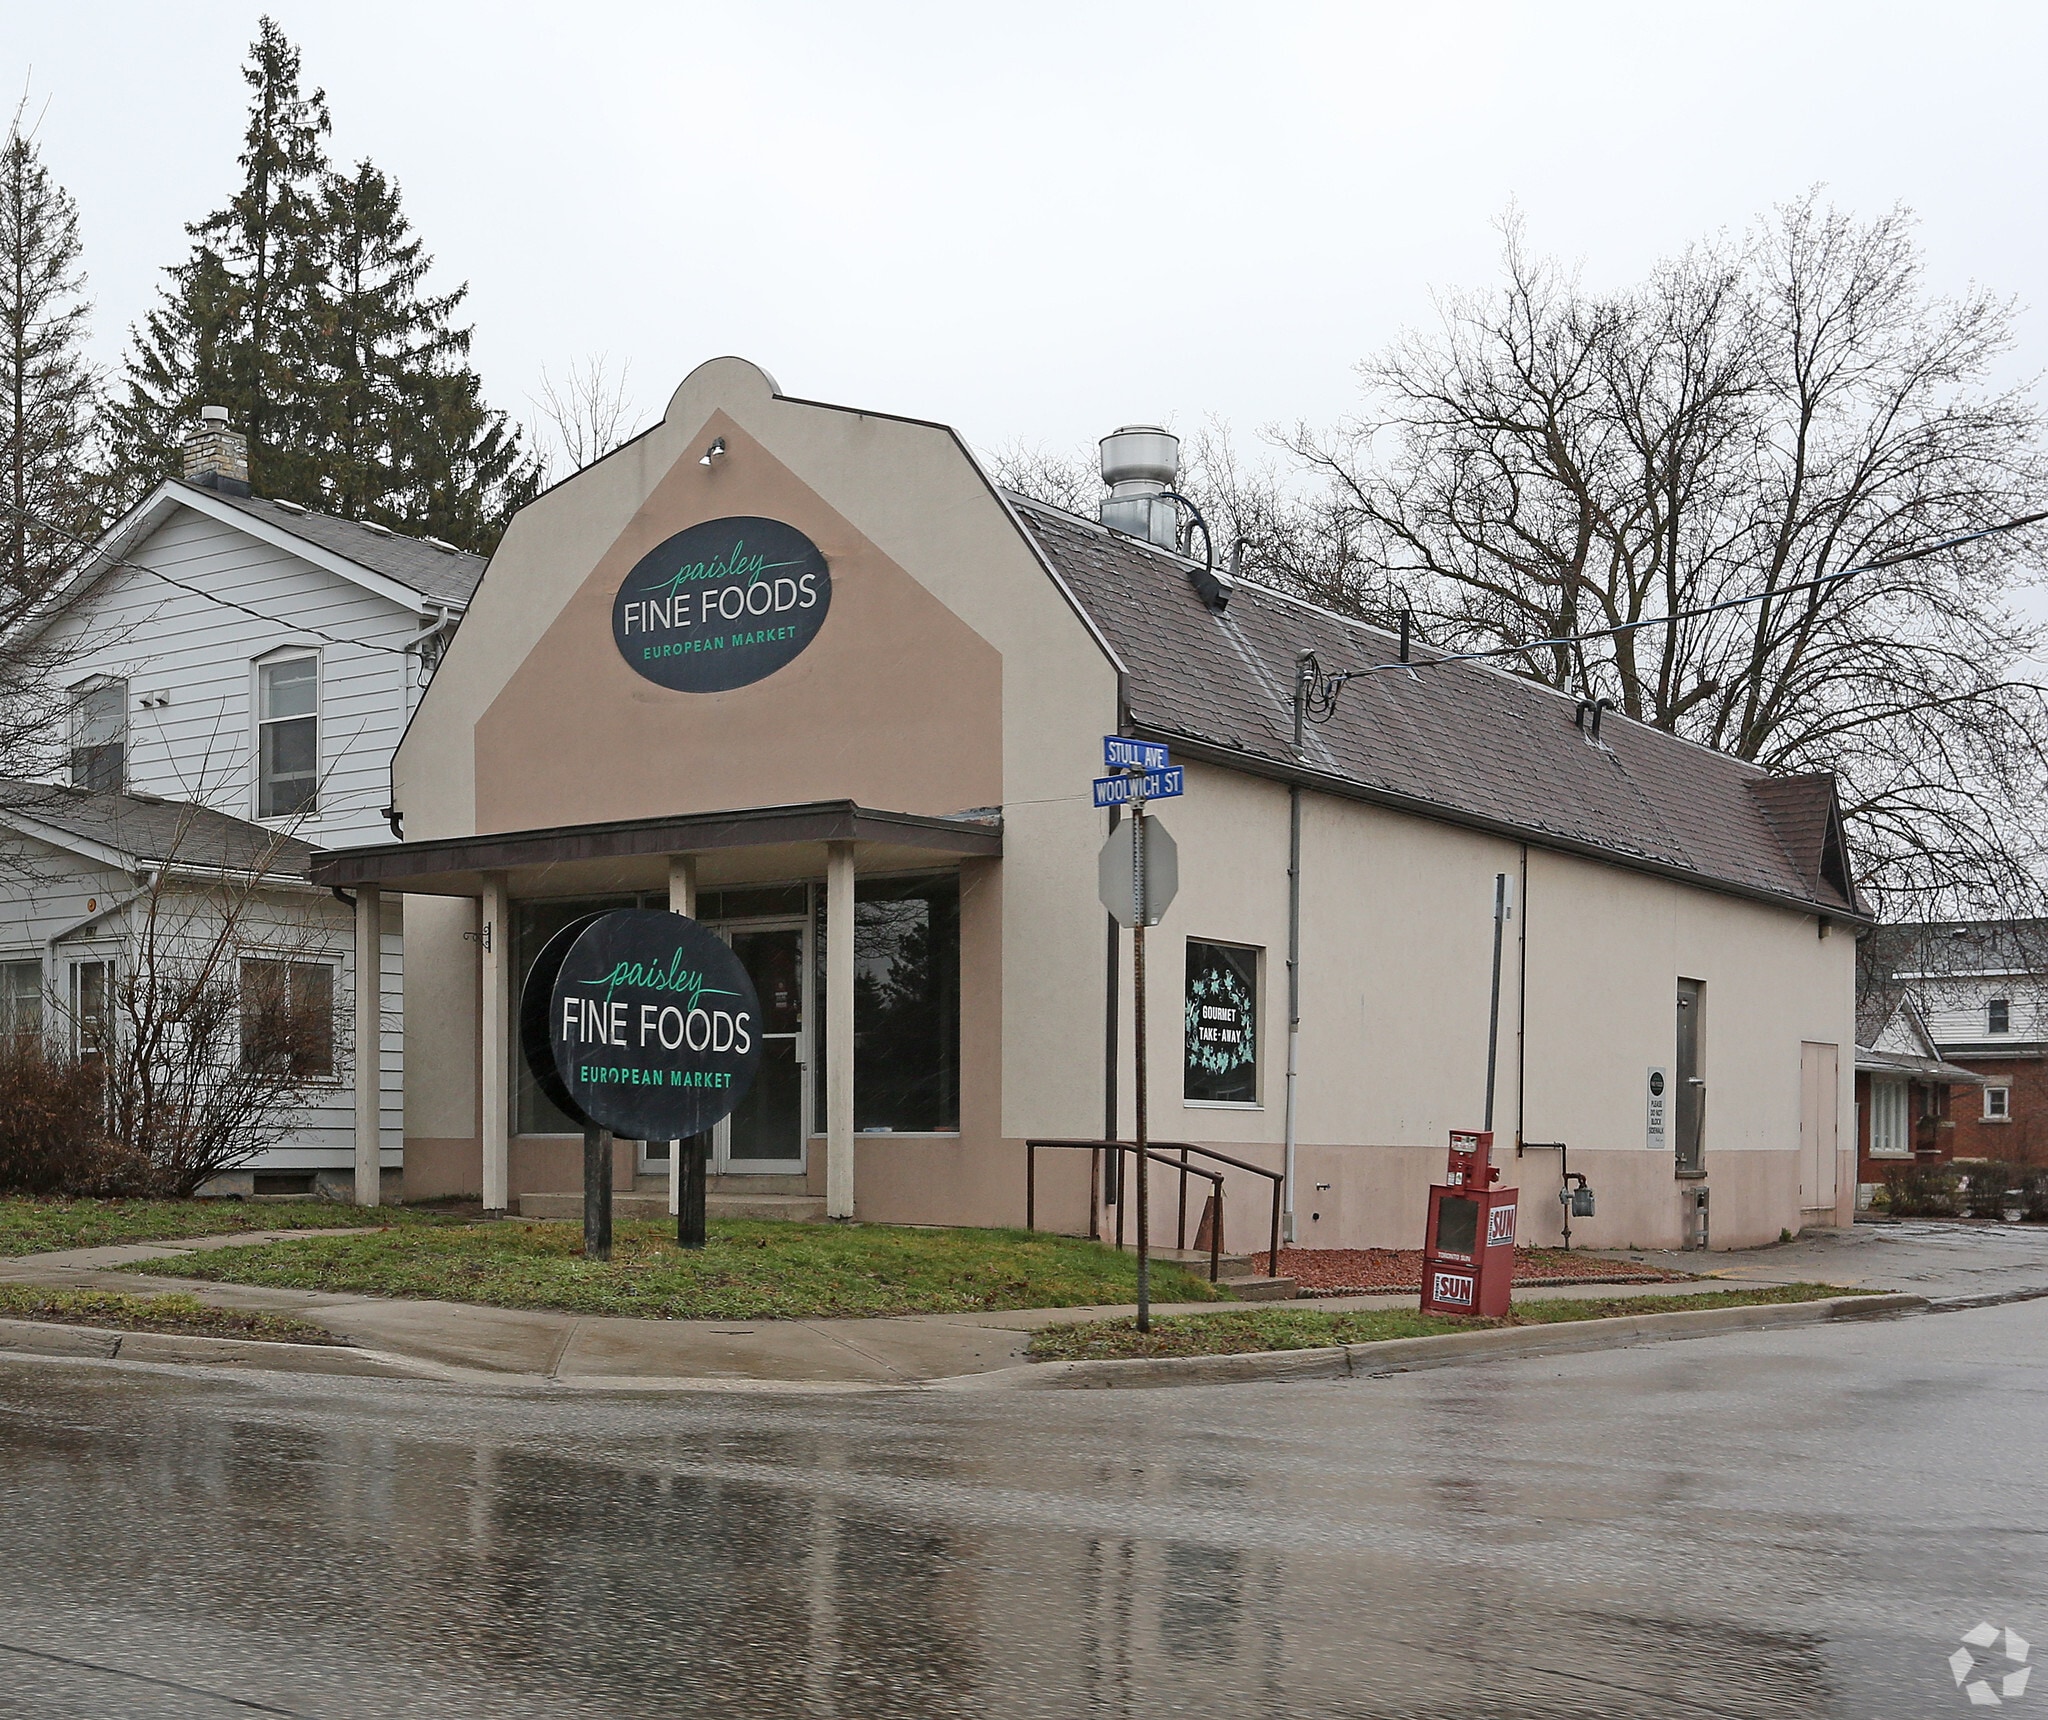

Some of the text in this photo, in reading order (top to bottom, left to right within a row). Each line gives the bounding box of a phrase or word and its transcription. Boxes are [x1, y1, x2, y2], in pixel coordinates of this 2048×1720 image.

[640, 540, 805, 599] paisley
[624, 573, 817, 635] FINE FOODS
[643, 625, 796, 660] EUROPEAN MARKET
[1108, 741, 1165, 769] STULL AVE
[1096, 771, 1180, 803] WOOLWICH ST
[577, 946, 743, 1012] paisley
[562, 996, 751, 1055] FINE FOODS
[1202, 1005, 1237, 1022] GOURMET
[1198, 1026, 1242, 1043] TAKE-AWAY
[580, 1065, 732, 1089] EUROPEAN MARKET
[1492, 1209, 1514, 1238] SUN
[1440, 1277, 1471, 1300] SUN
